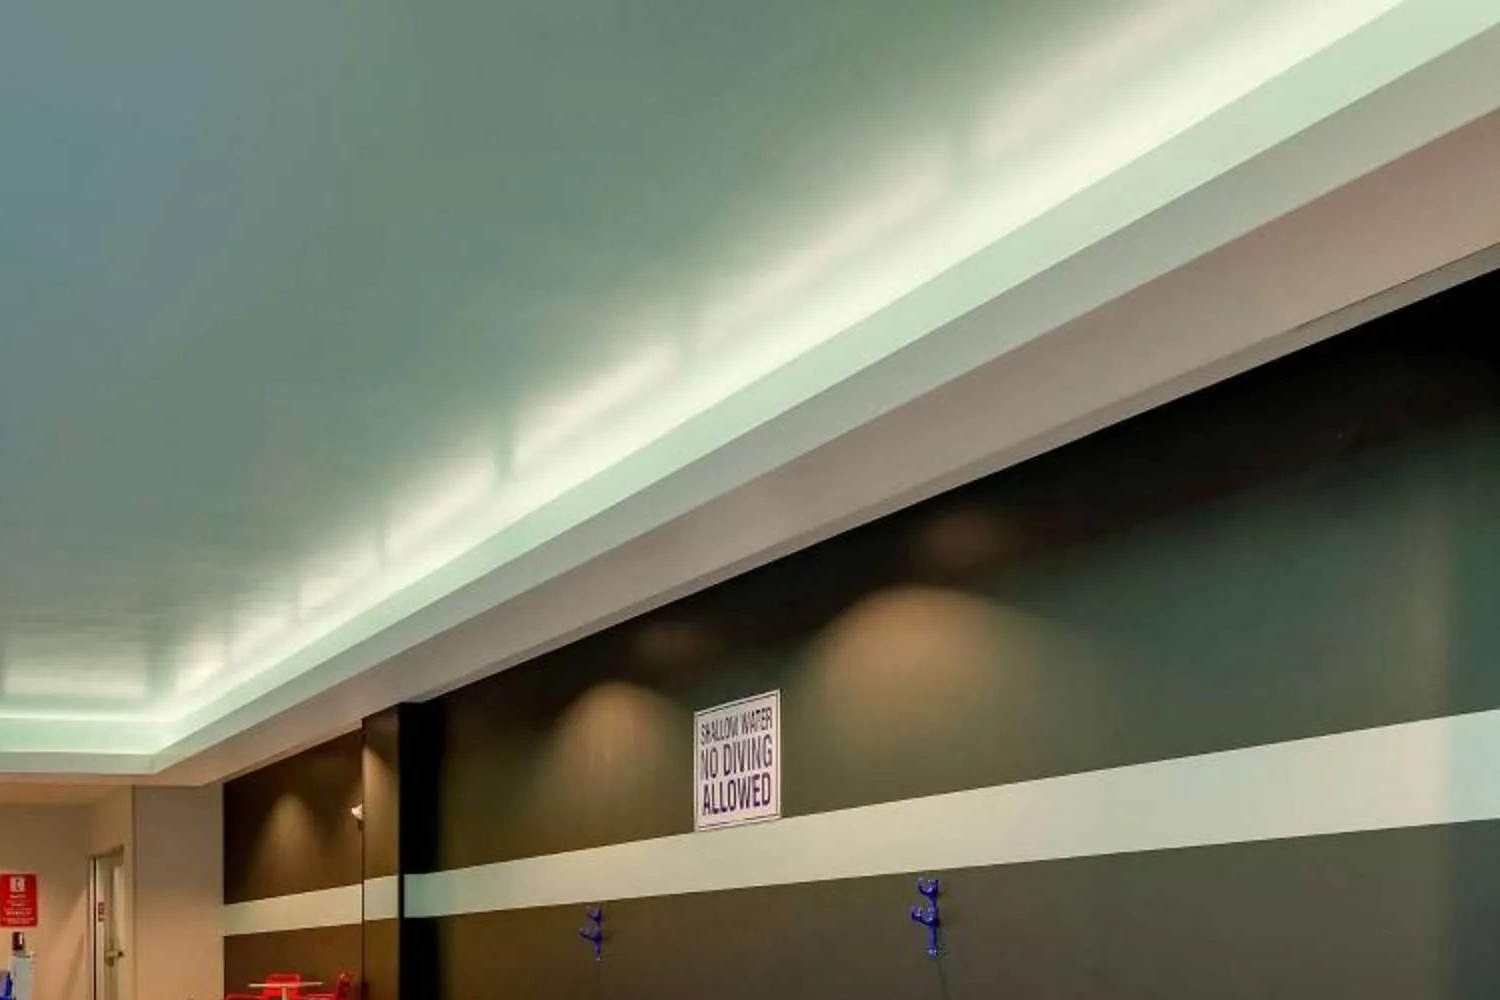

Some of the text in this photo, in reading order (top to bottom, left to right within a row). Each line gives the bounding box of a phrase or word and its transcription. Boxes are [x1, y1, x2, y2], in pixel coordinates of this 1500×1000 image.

[700, 707, 773, 745] SHALLOW WATER
[701, 734, 773, 780] NO DIVING
[702, 772, 772, 816] ALLOWED
